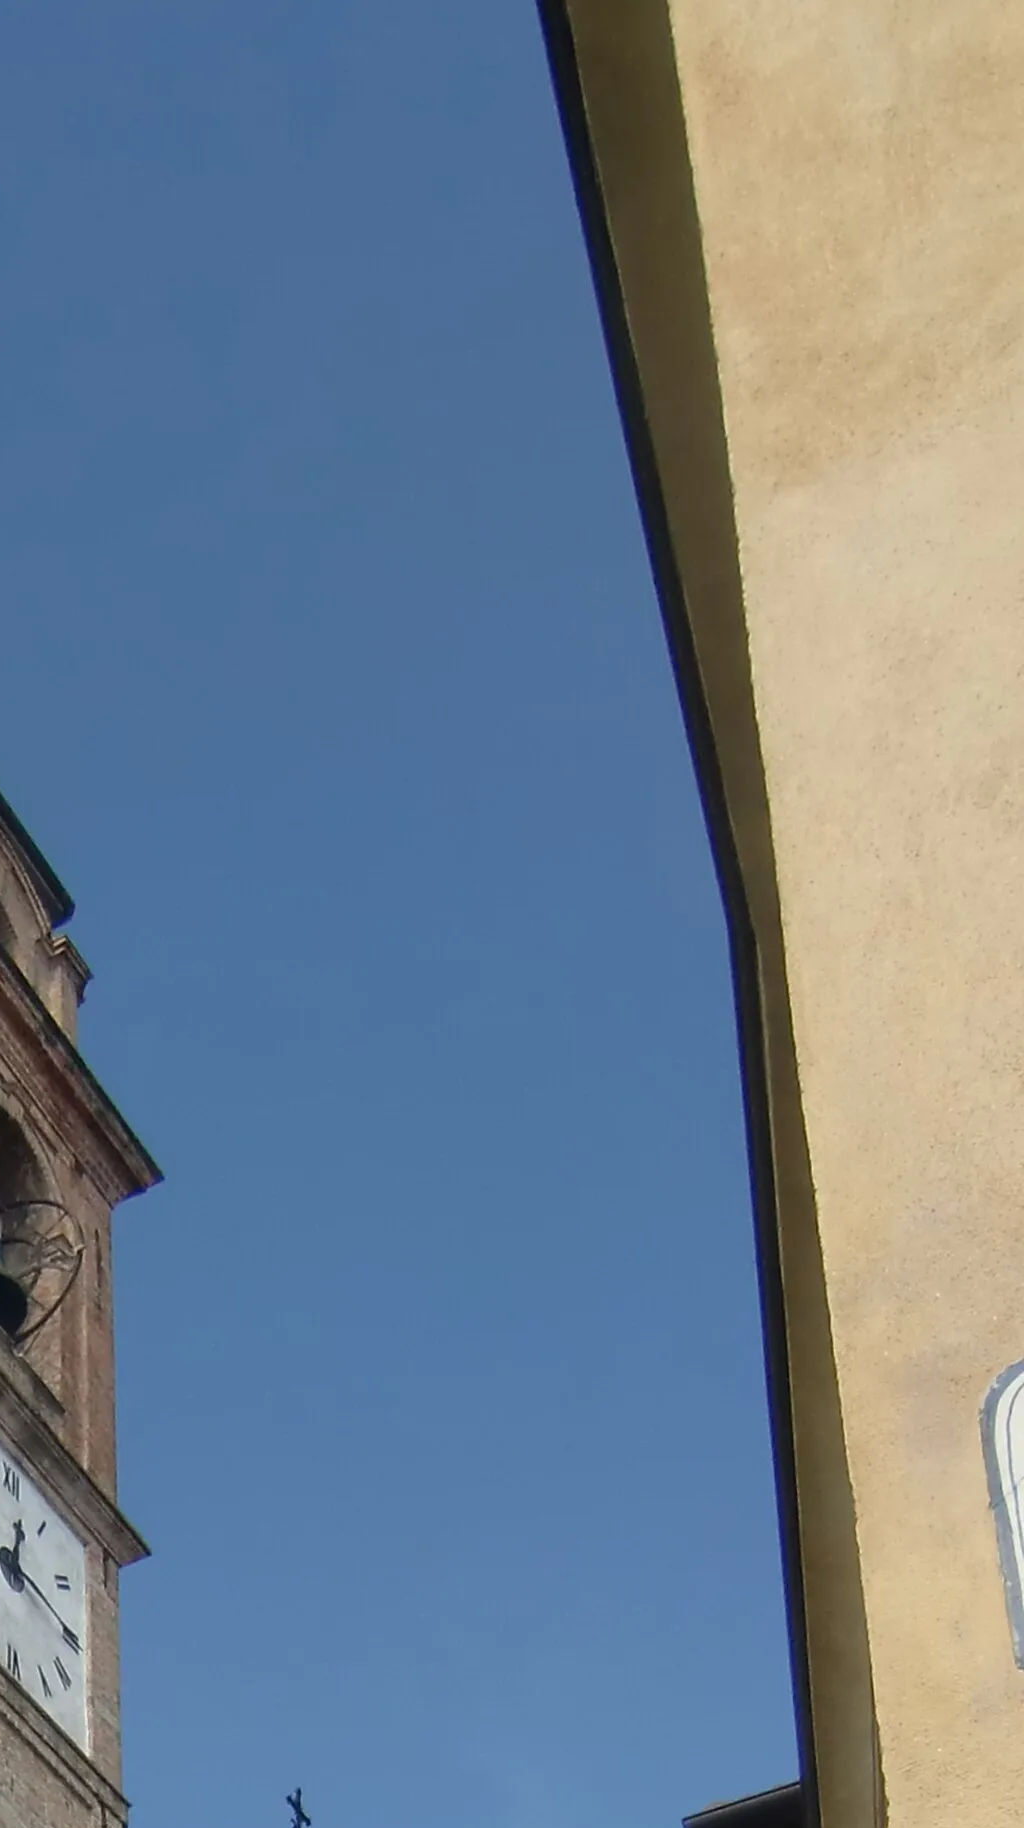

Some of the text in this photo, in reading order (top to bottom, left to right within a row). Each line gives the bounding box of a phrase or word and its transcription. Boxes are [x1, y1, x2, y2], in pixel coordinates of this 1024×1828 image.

[2, 1460, 20, 1502] XII
[36, 1520, 47, 1537] I
[54, 1574, 71, 1591] II
[7, 1643, 21, 1682] VI
[37, 1664, 52, 1698] V
